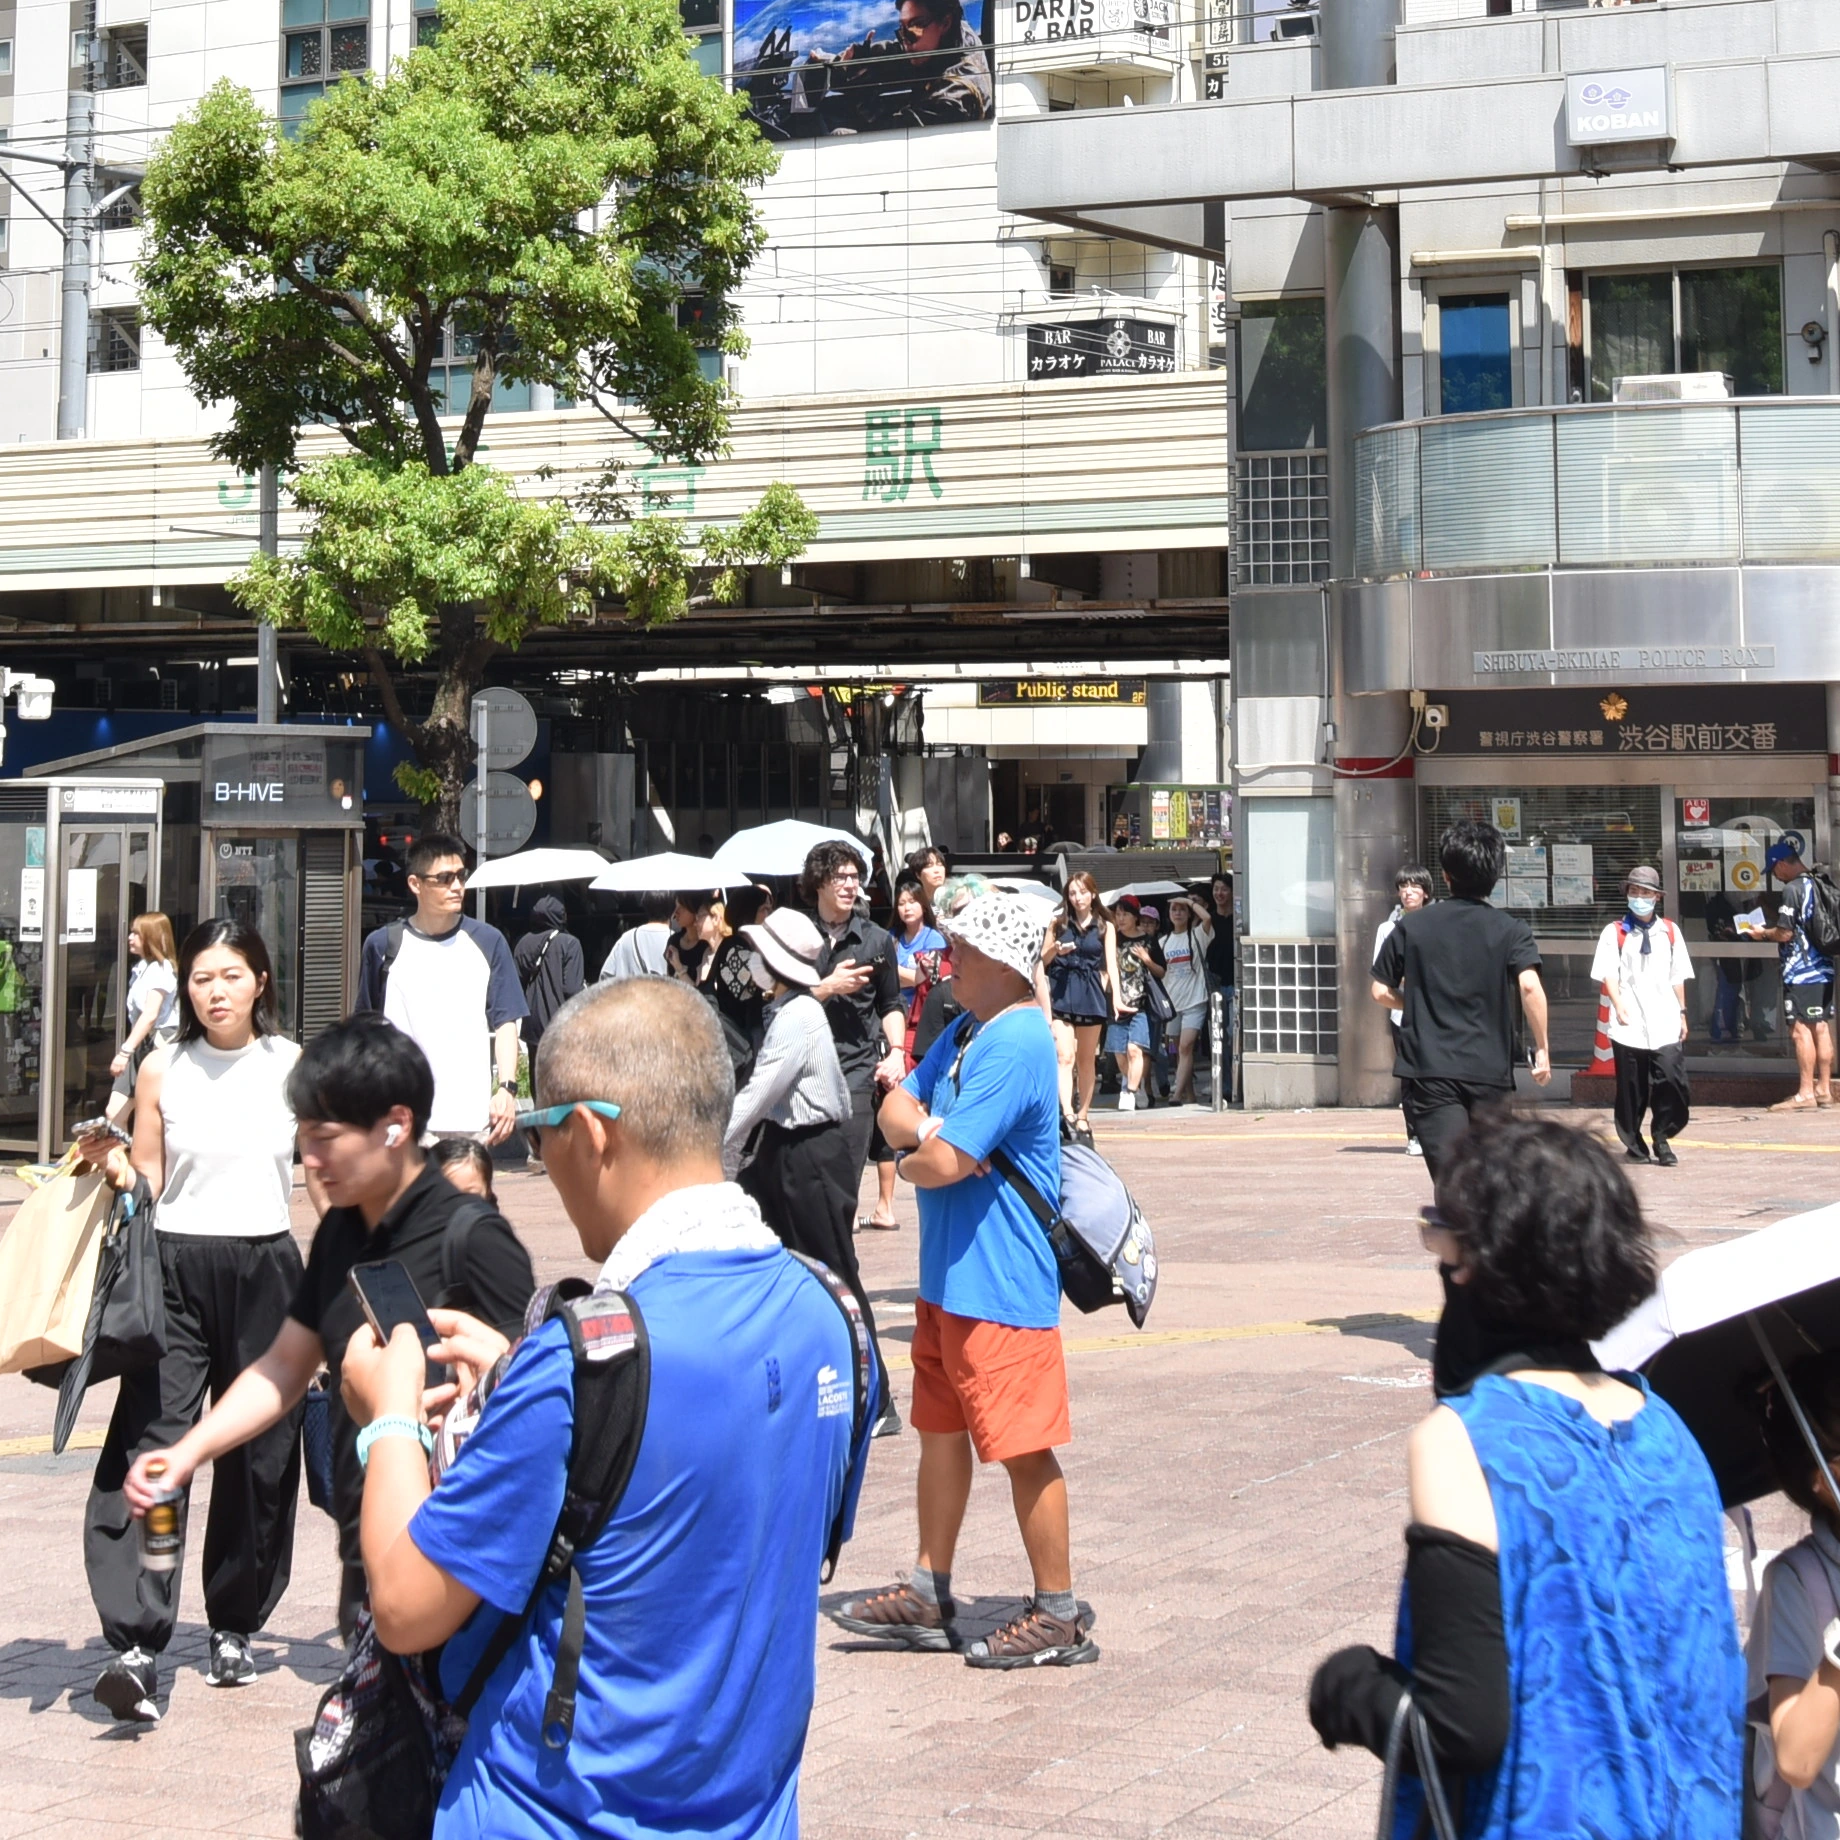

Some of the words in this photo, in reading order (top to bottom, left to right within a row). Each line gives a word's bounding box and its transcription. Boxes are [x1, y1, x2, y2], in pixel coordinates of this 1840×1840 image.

[1024, 30, 1036, 45] &
[1047, 18, 1094, 43] BAR
[1045, 329, 1071, 345] BAR
[1114, 321, 1125, 329] 4F
[1147, 329, 1166, 346] BAR
[1031, 354, 1086, 373] カラオケ
[1138, 352, 1175, 372] カラオケ
[1483, 651, 1621, 673] SHIBUYA-EKIMAE
[1639, 649, 1706, 669] POLICE
[1720, 647, 1761, 667] BOX
[1016, 680, 1068, 700] Public
[1072, 680, 1120, 699] stand
[1132, 692, 1145, 703] 2F
[1479, 729, 1605, 748] 警視庁渋谷警察署
[1618, 722, 1778, 752] 渋谷駅前交番
[215, 782, 285, 803] B-HIVE
[1686, 799, 1708, 808] AED
[235, 846, 253, 856] NTT
